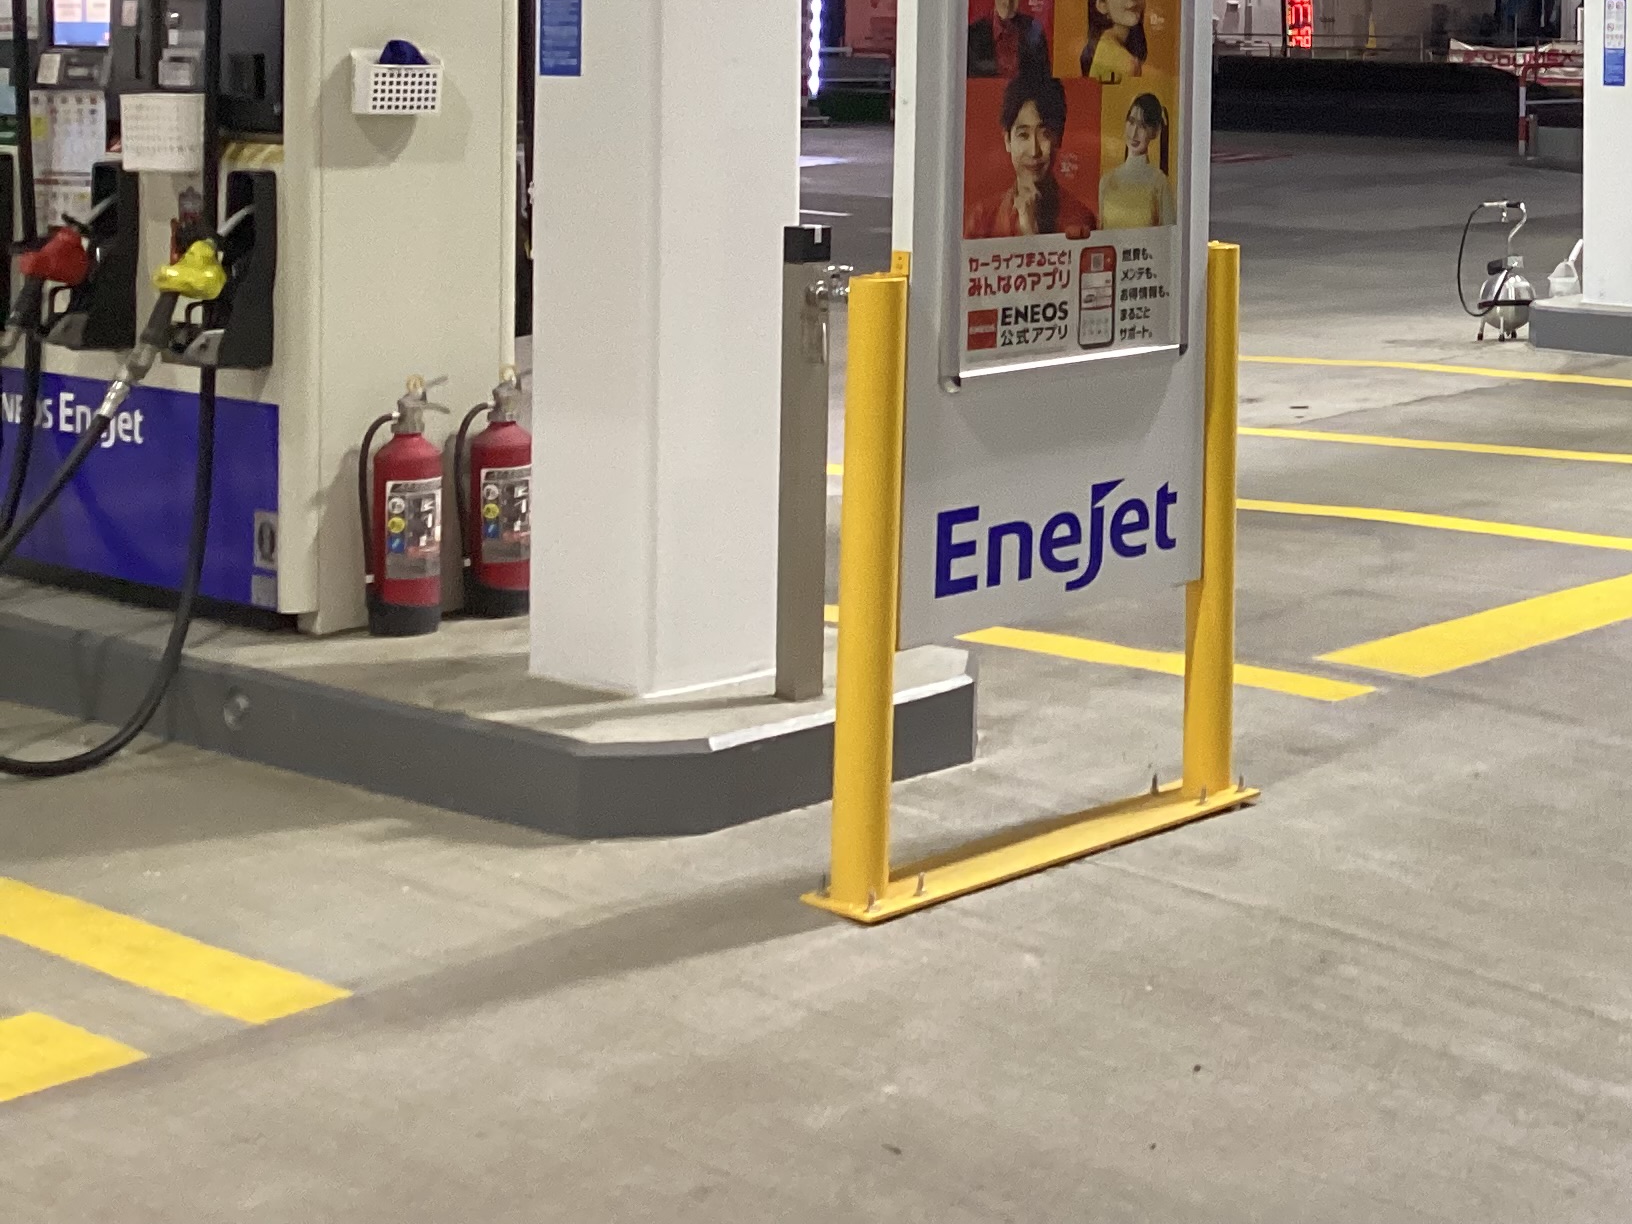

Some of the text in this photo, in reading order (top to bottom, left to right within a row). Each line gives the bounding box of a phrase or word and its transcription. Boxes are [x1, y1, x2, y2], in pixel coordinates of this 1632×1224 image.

[967, 268, 1071, 297] みんなのアプリ
[1001, 301, 1069, 326] ENEOS
[1120, 306, 1151, 322] まるごと
[1000, 324, 1069, 347] 公式アプリ
